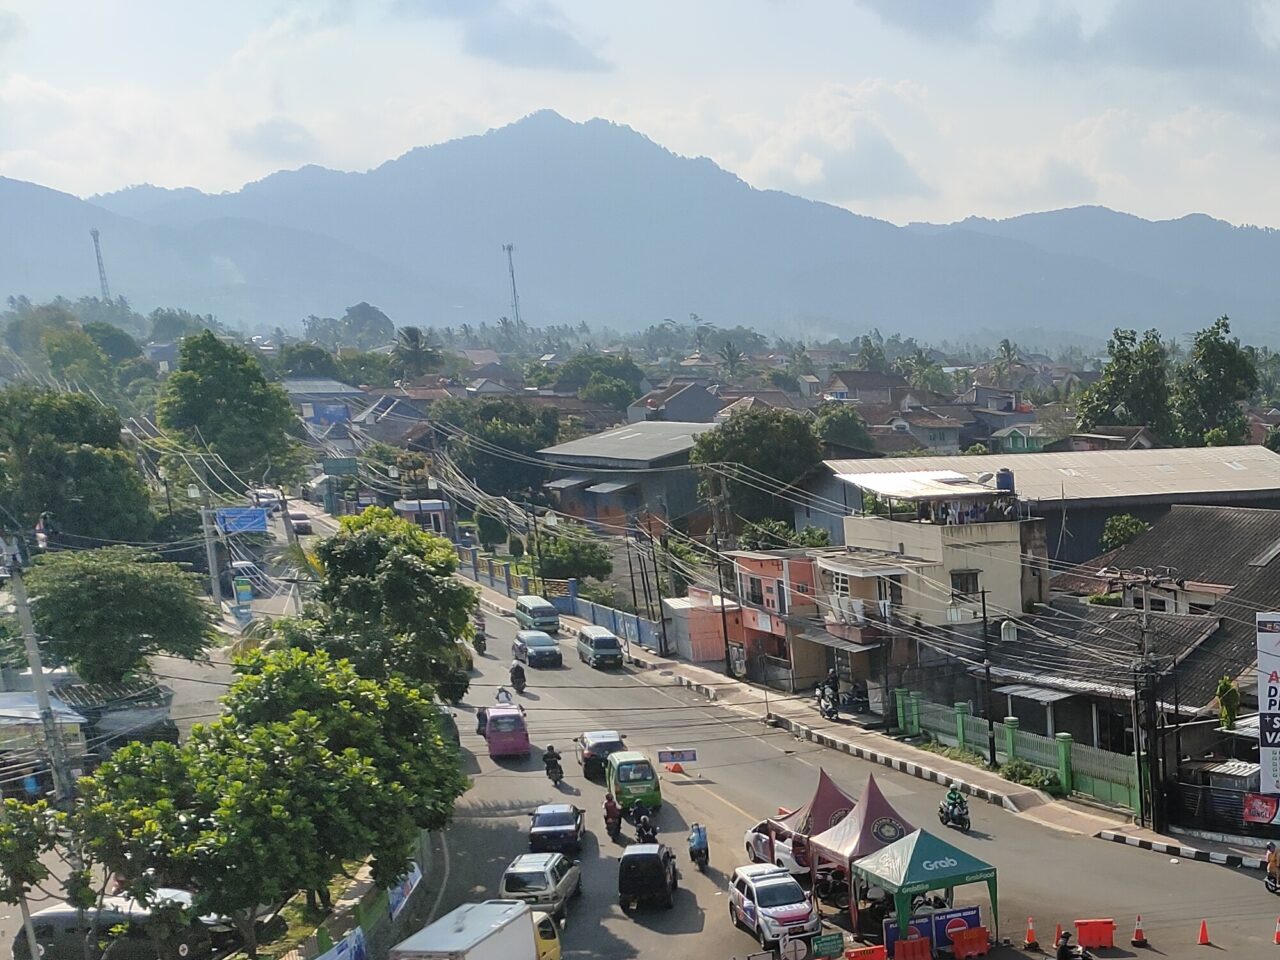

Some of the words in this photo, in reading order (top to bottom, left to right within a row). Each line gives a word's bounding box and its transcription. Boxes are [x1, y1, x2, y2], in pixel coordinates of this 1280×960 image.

[922, 857, 958, 871] Grab
[966, 871, 996, 882] GrabFood
[768, 902, 810, 914] POLISI
